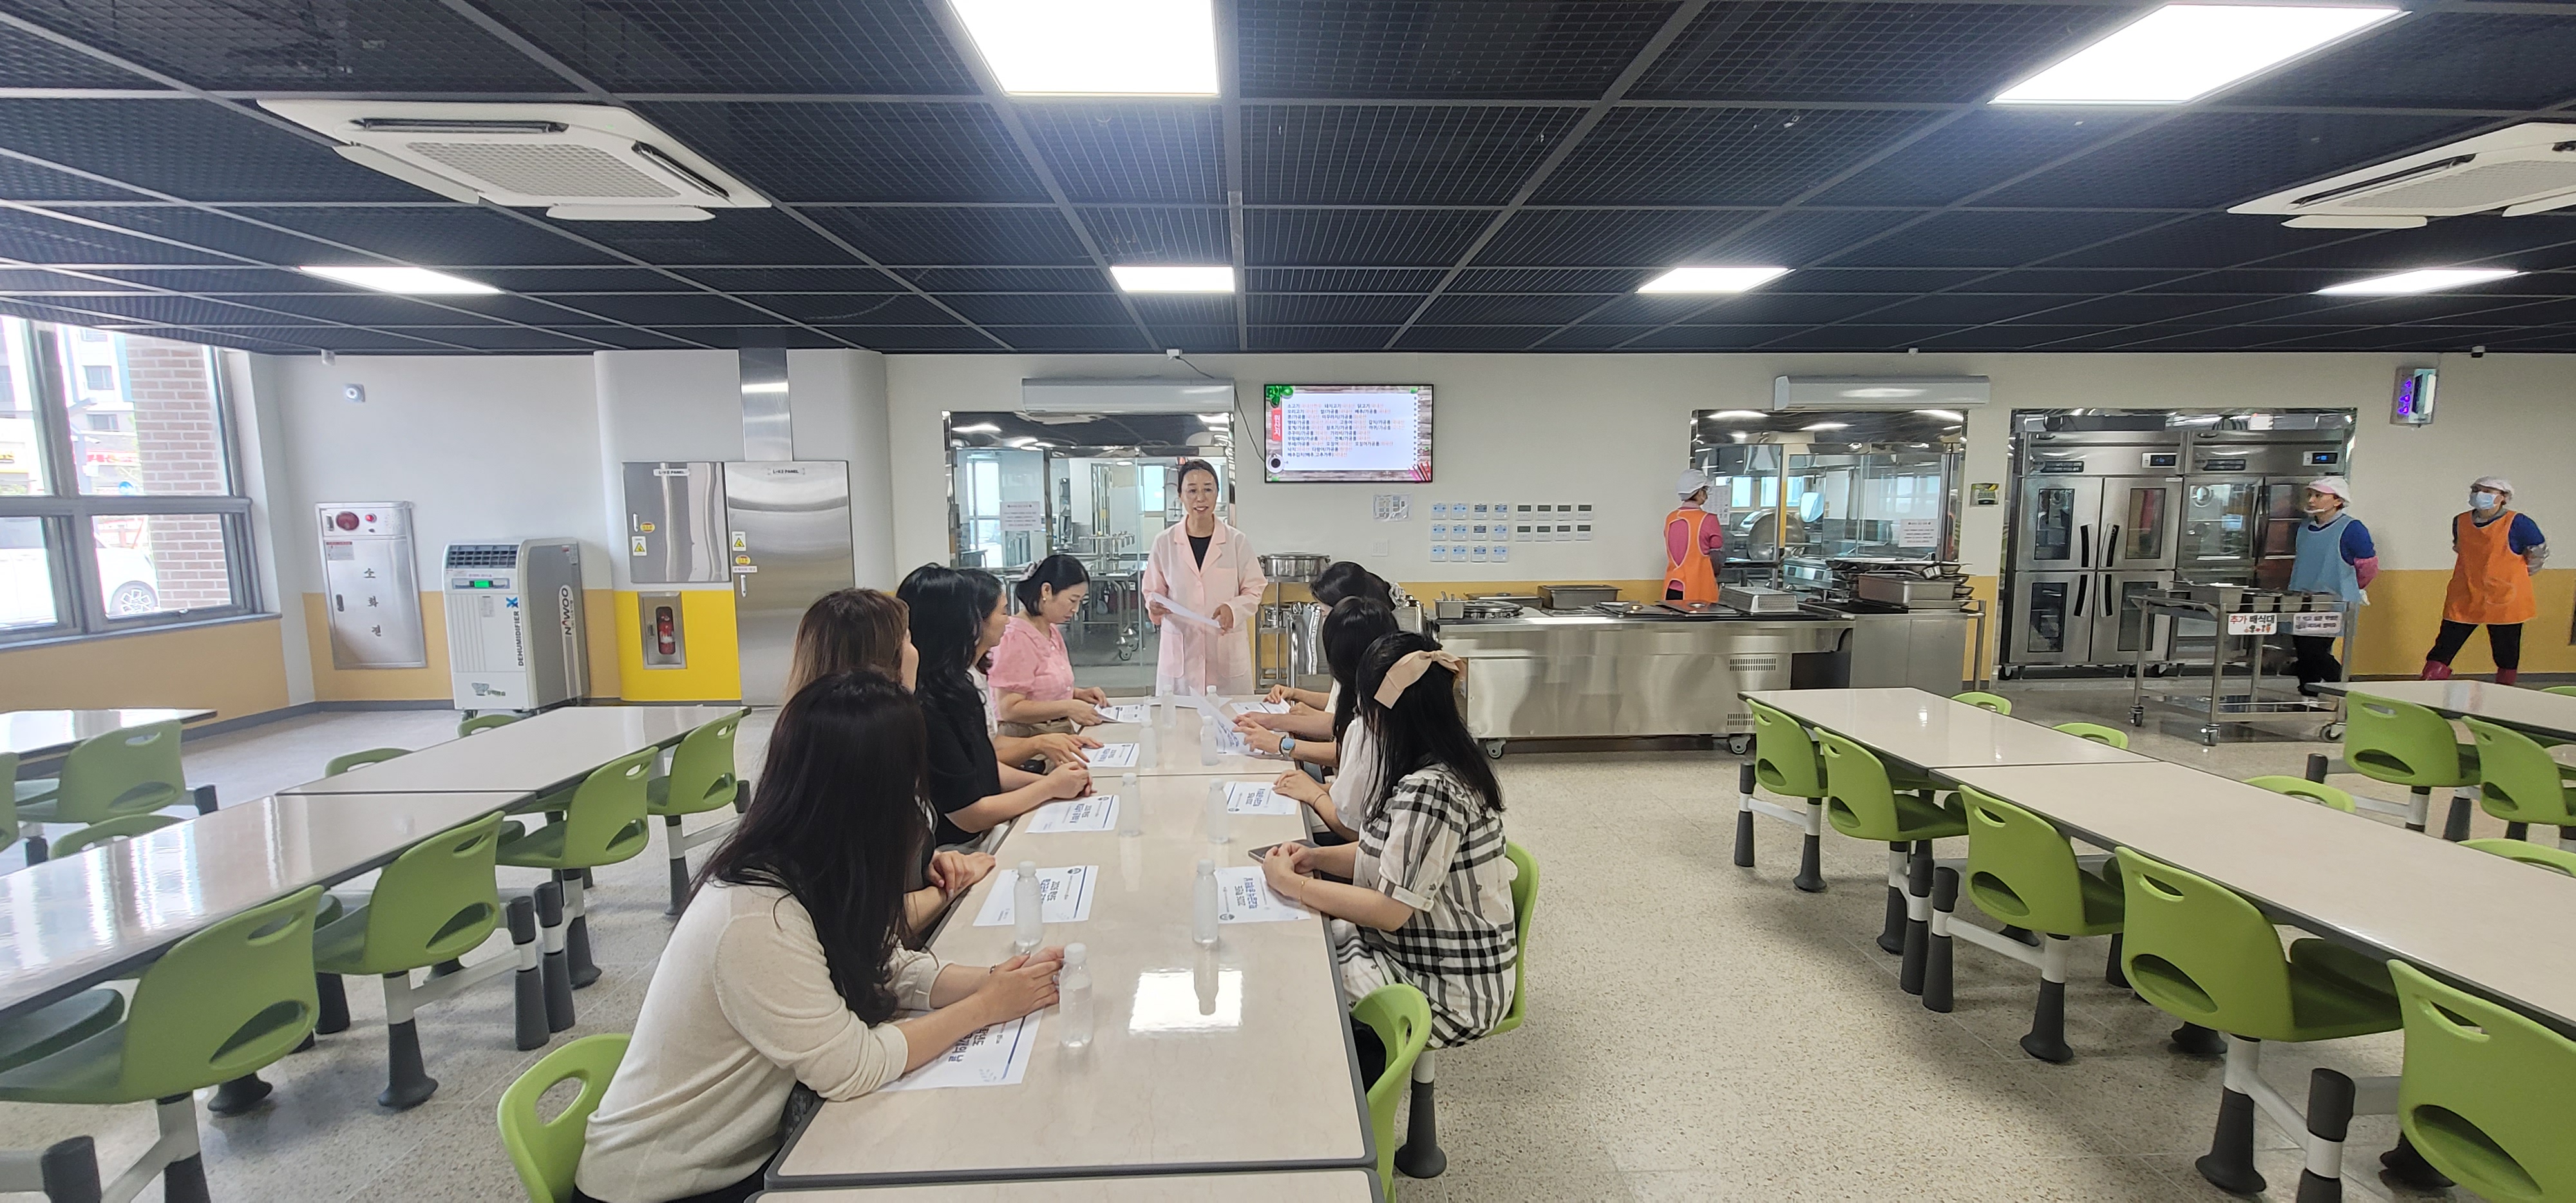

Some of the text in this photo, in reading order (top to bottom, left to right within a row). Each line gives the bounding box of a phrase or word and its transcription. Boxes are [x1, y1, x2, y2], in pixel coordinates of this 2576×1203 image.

[2230, 614, 2275, 625] 추가 배식대
[513, 611, 524, 667] DEHUMIDIFIER
[972, 1027, 989, 1047] 학년도
